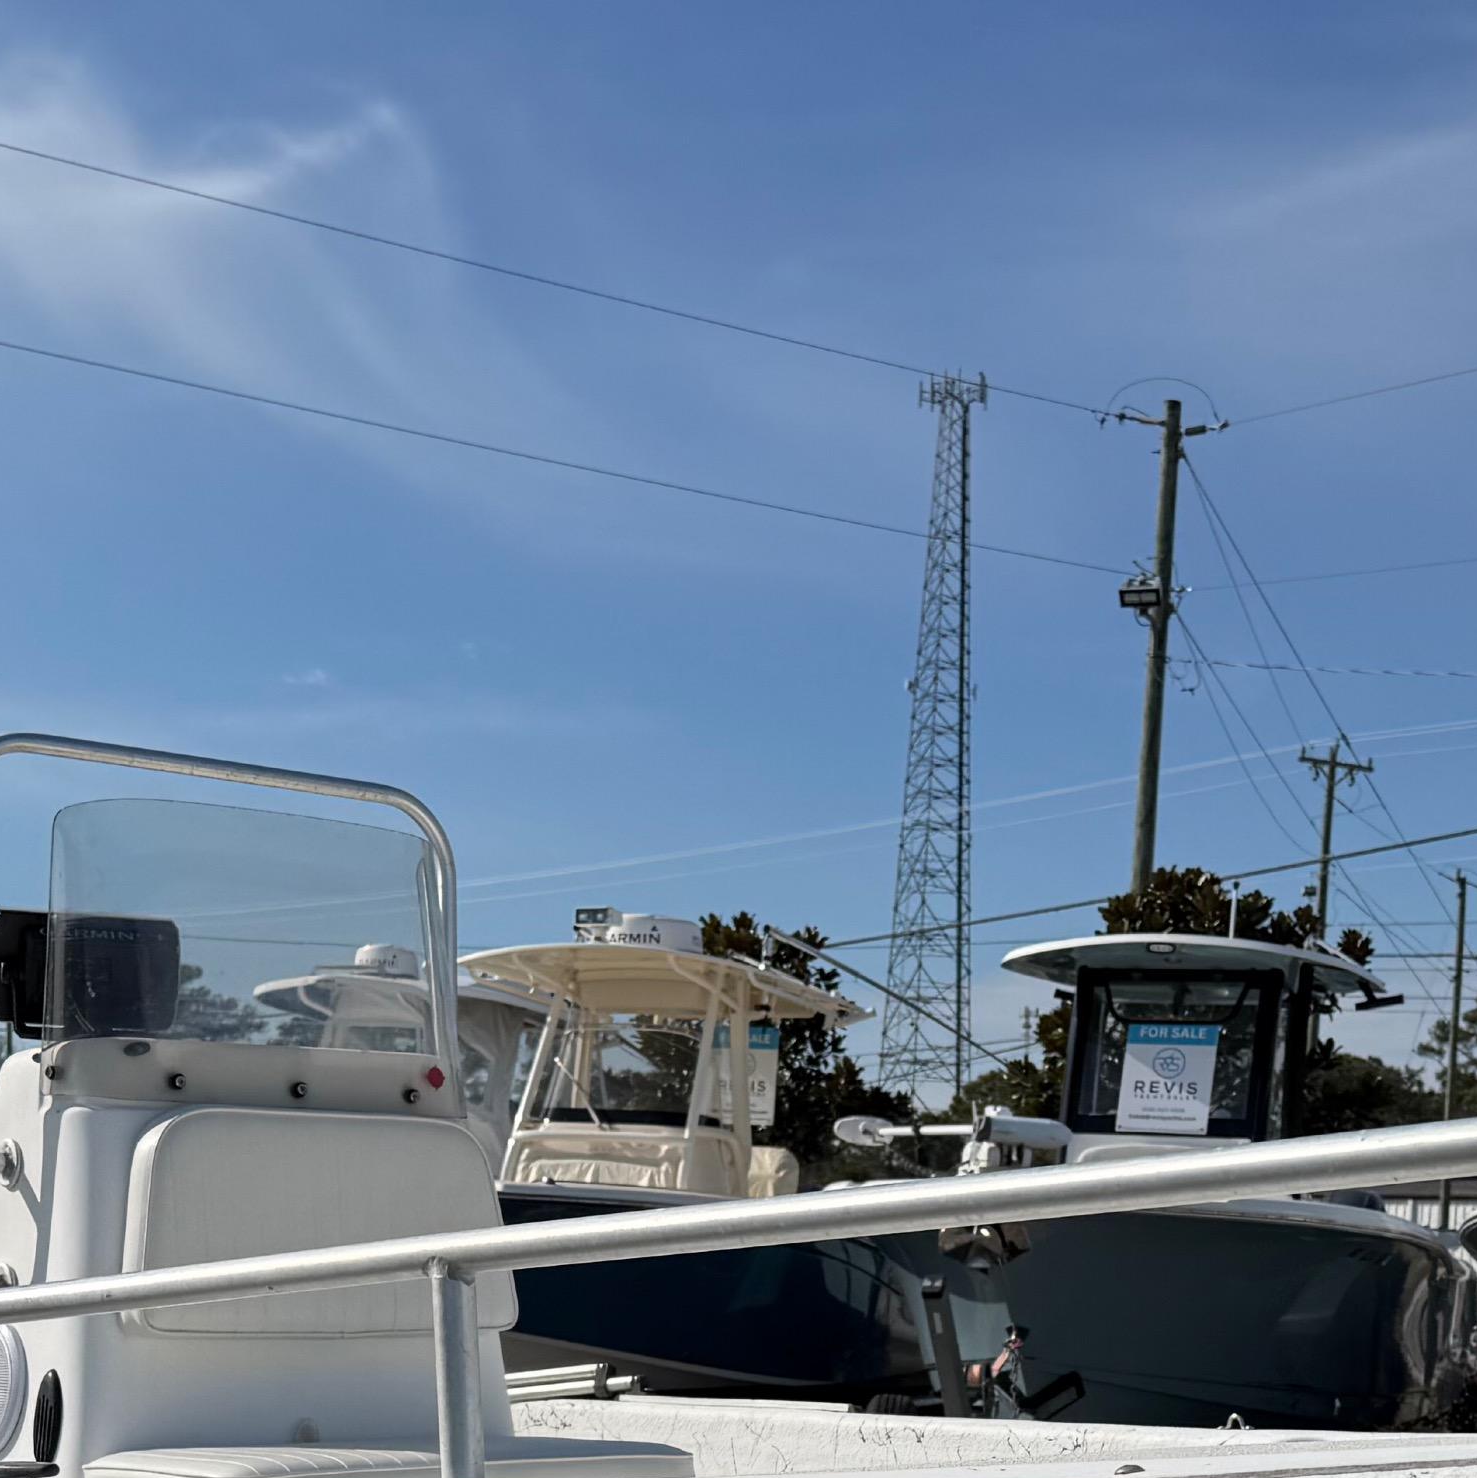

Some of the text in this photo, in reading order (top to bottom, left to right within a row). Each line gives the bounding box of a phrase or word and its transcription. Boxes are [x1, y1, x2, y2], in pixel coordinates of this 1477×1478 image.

[39, 926, 136, 941] GRMIN
[608, 932, 661, 945] ARMIN
[1139, 1026, 1208, 1040] FOR SALE
[1133, 1080, 1199, 1095] REVIS
